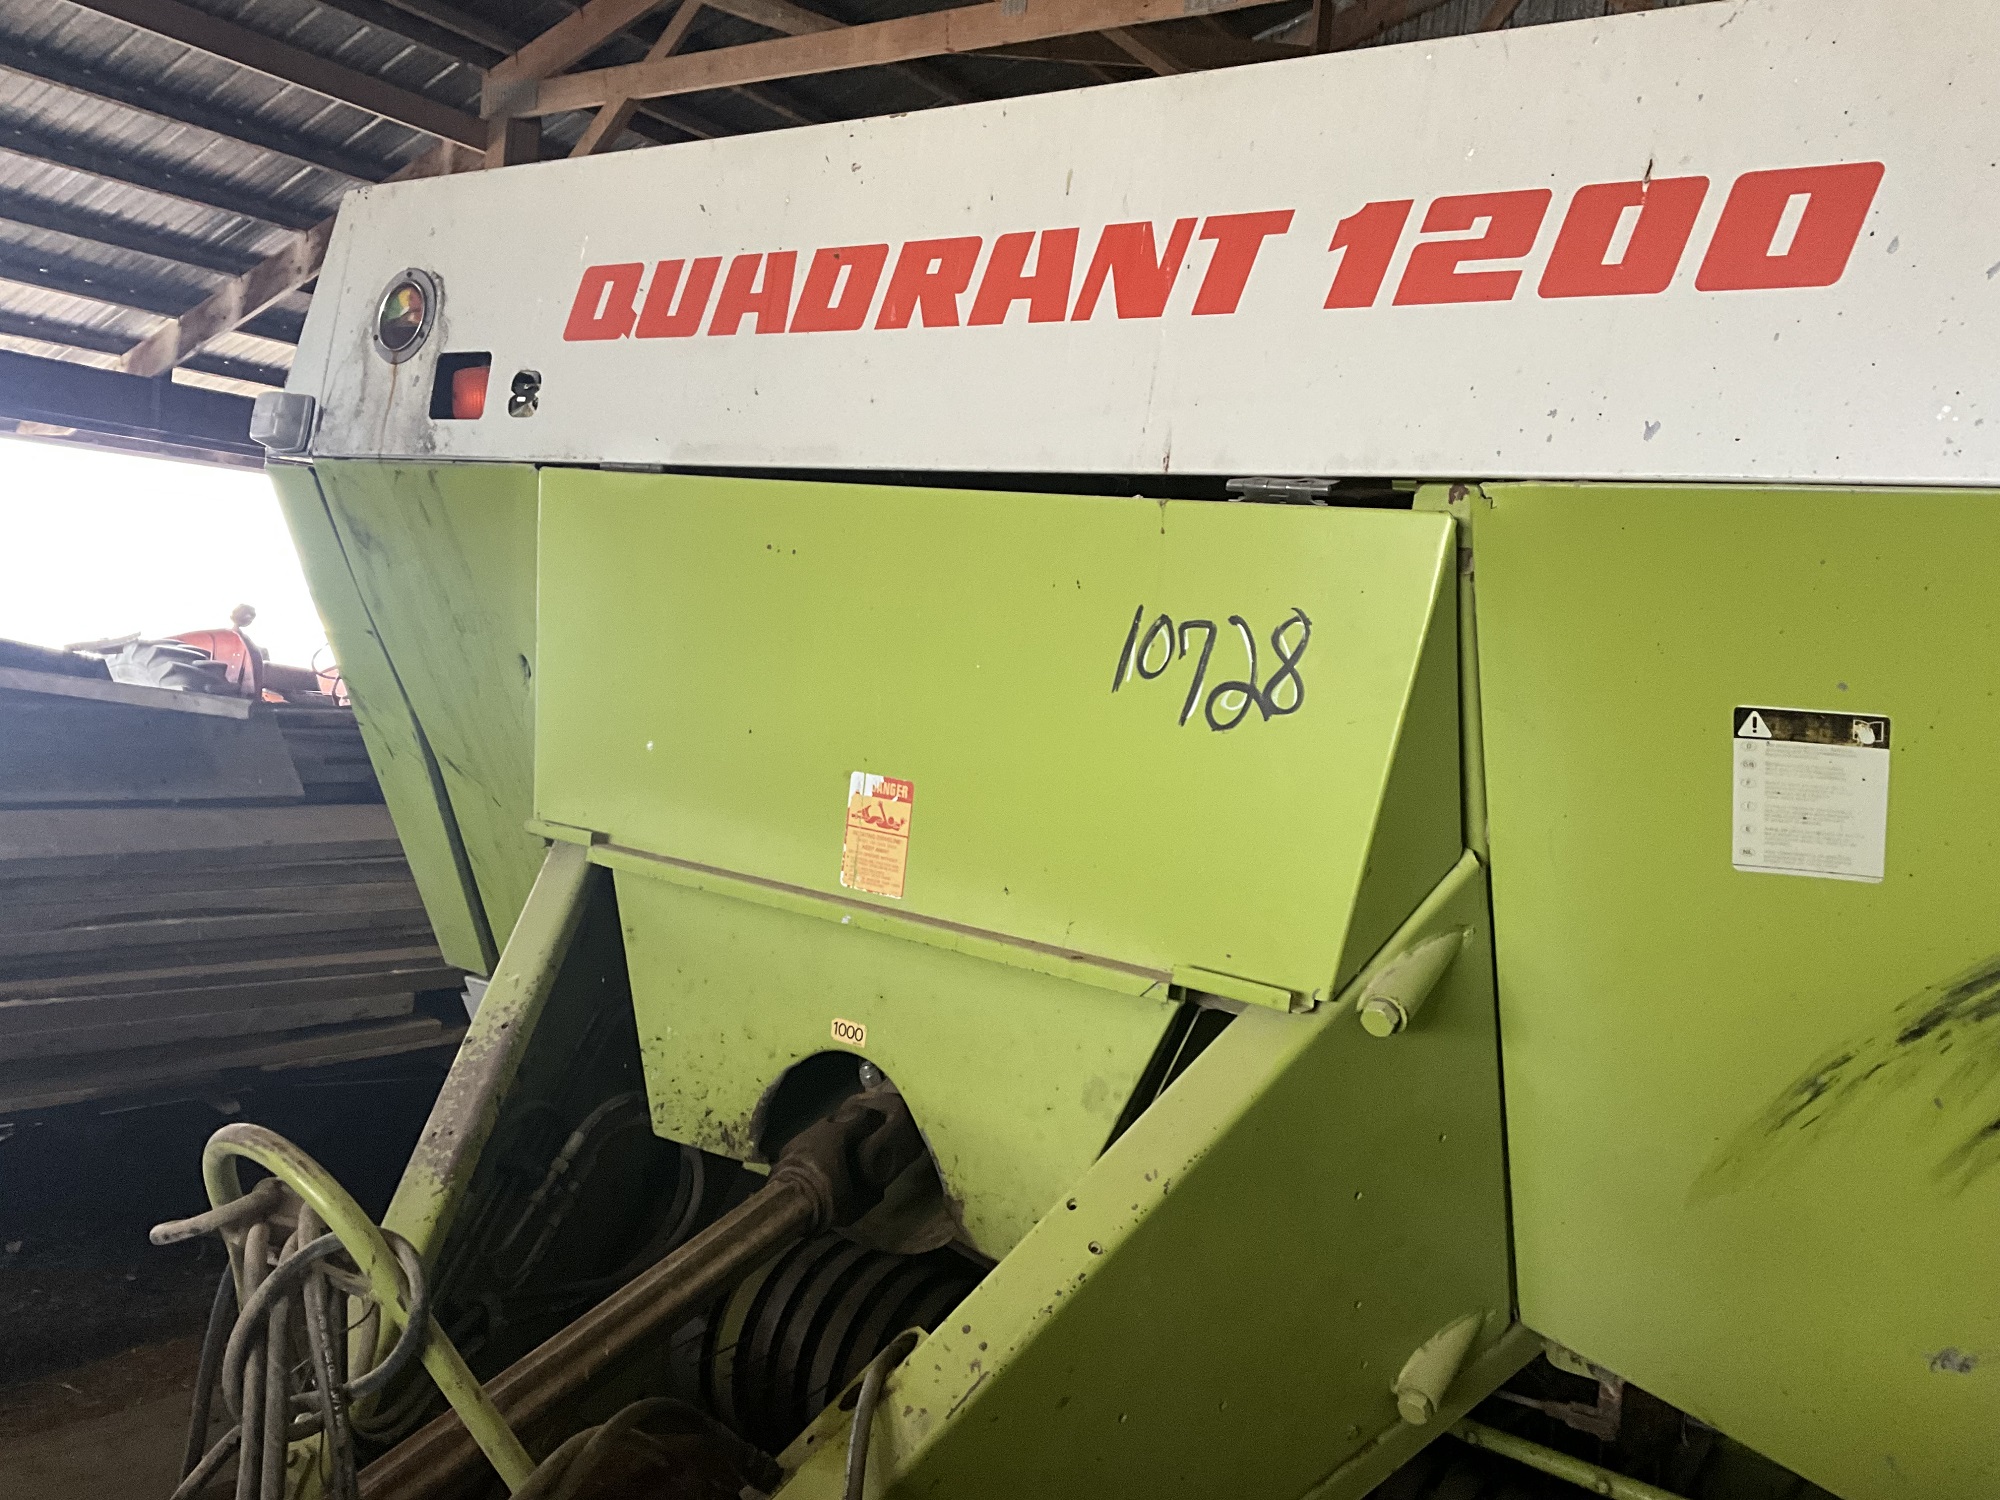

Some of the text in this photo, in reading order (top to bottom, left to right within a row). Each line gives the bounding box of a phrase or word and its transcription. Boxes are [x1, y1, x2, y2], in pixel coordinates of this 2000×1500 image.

[563, 161, 1885, 342] QUADRANT 1200
[1111, 604, 1312, 732] 10728
[833, 1021, 864, 1042] 1000
